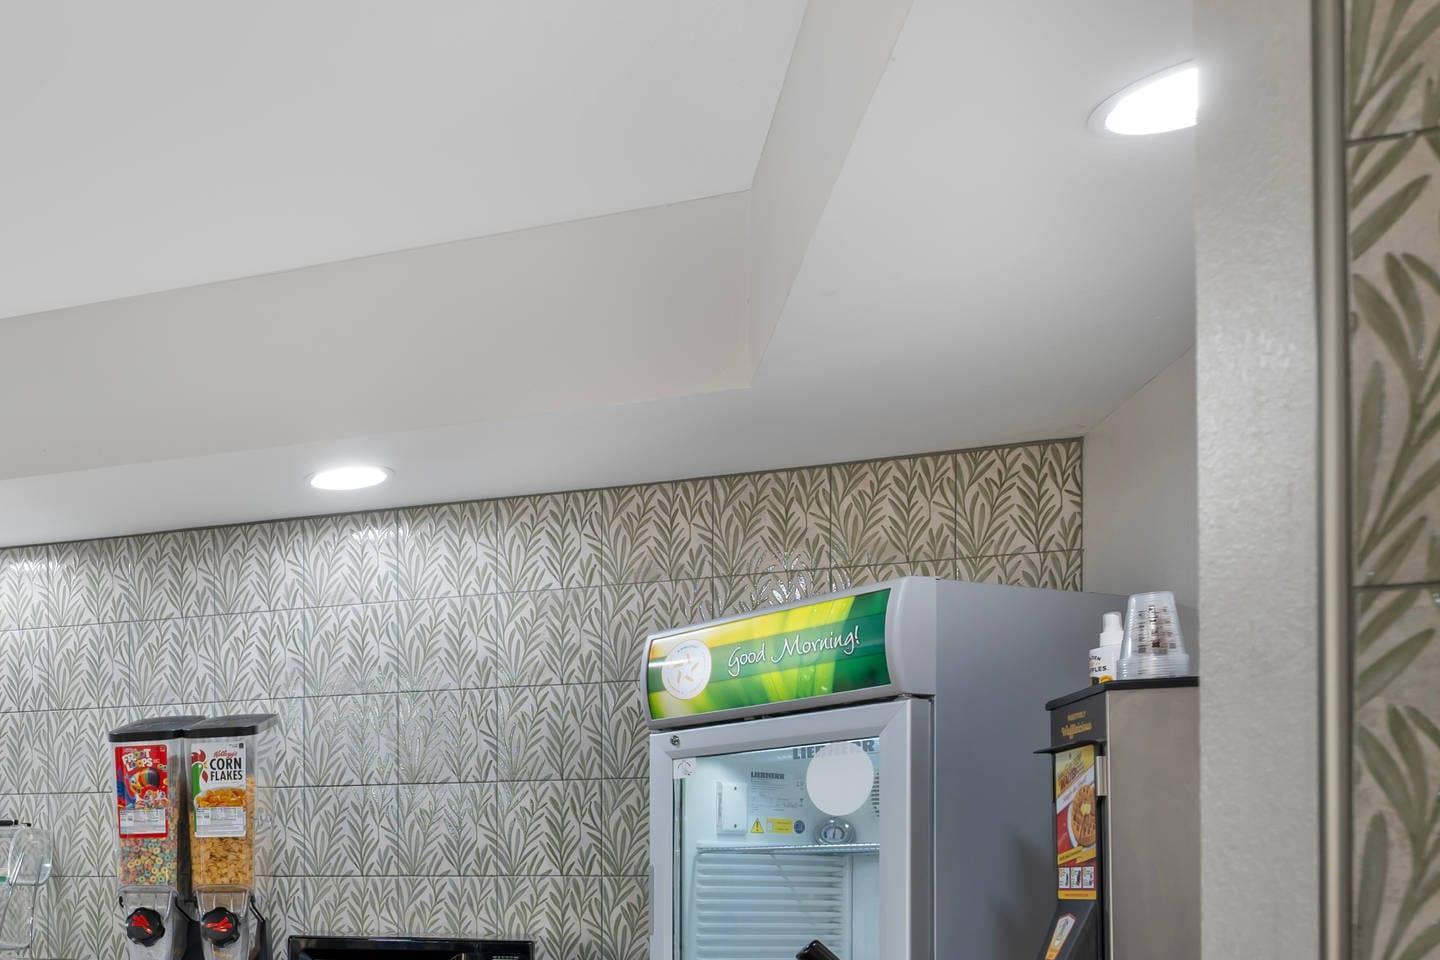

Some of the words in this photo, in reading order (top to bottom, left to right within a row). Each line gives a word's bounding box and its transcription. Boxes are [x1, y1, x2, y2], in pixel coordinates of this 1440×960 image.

[728, 643, 766, 677] Good
[770, 625, 860, 663] Morning!
[210, 758, 242, 770] CORN
[211, 770, 243, 781] FLAKES
